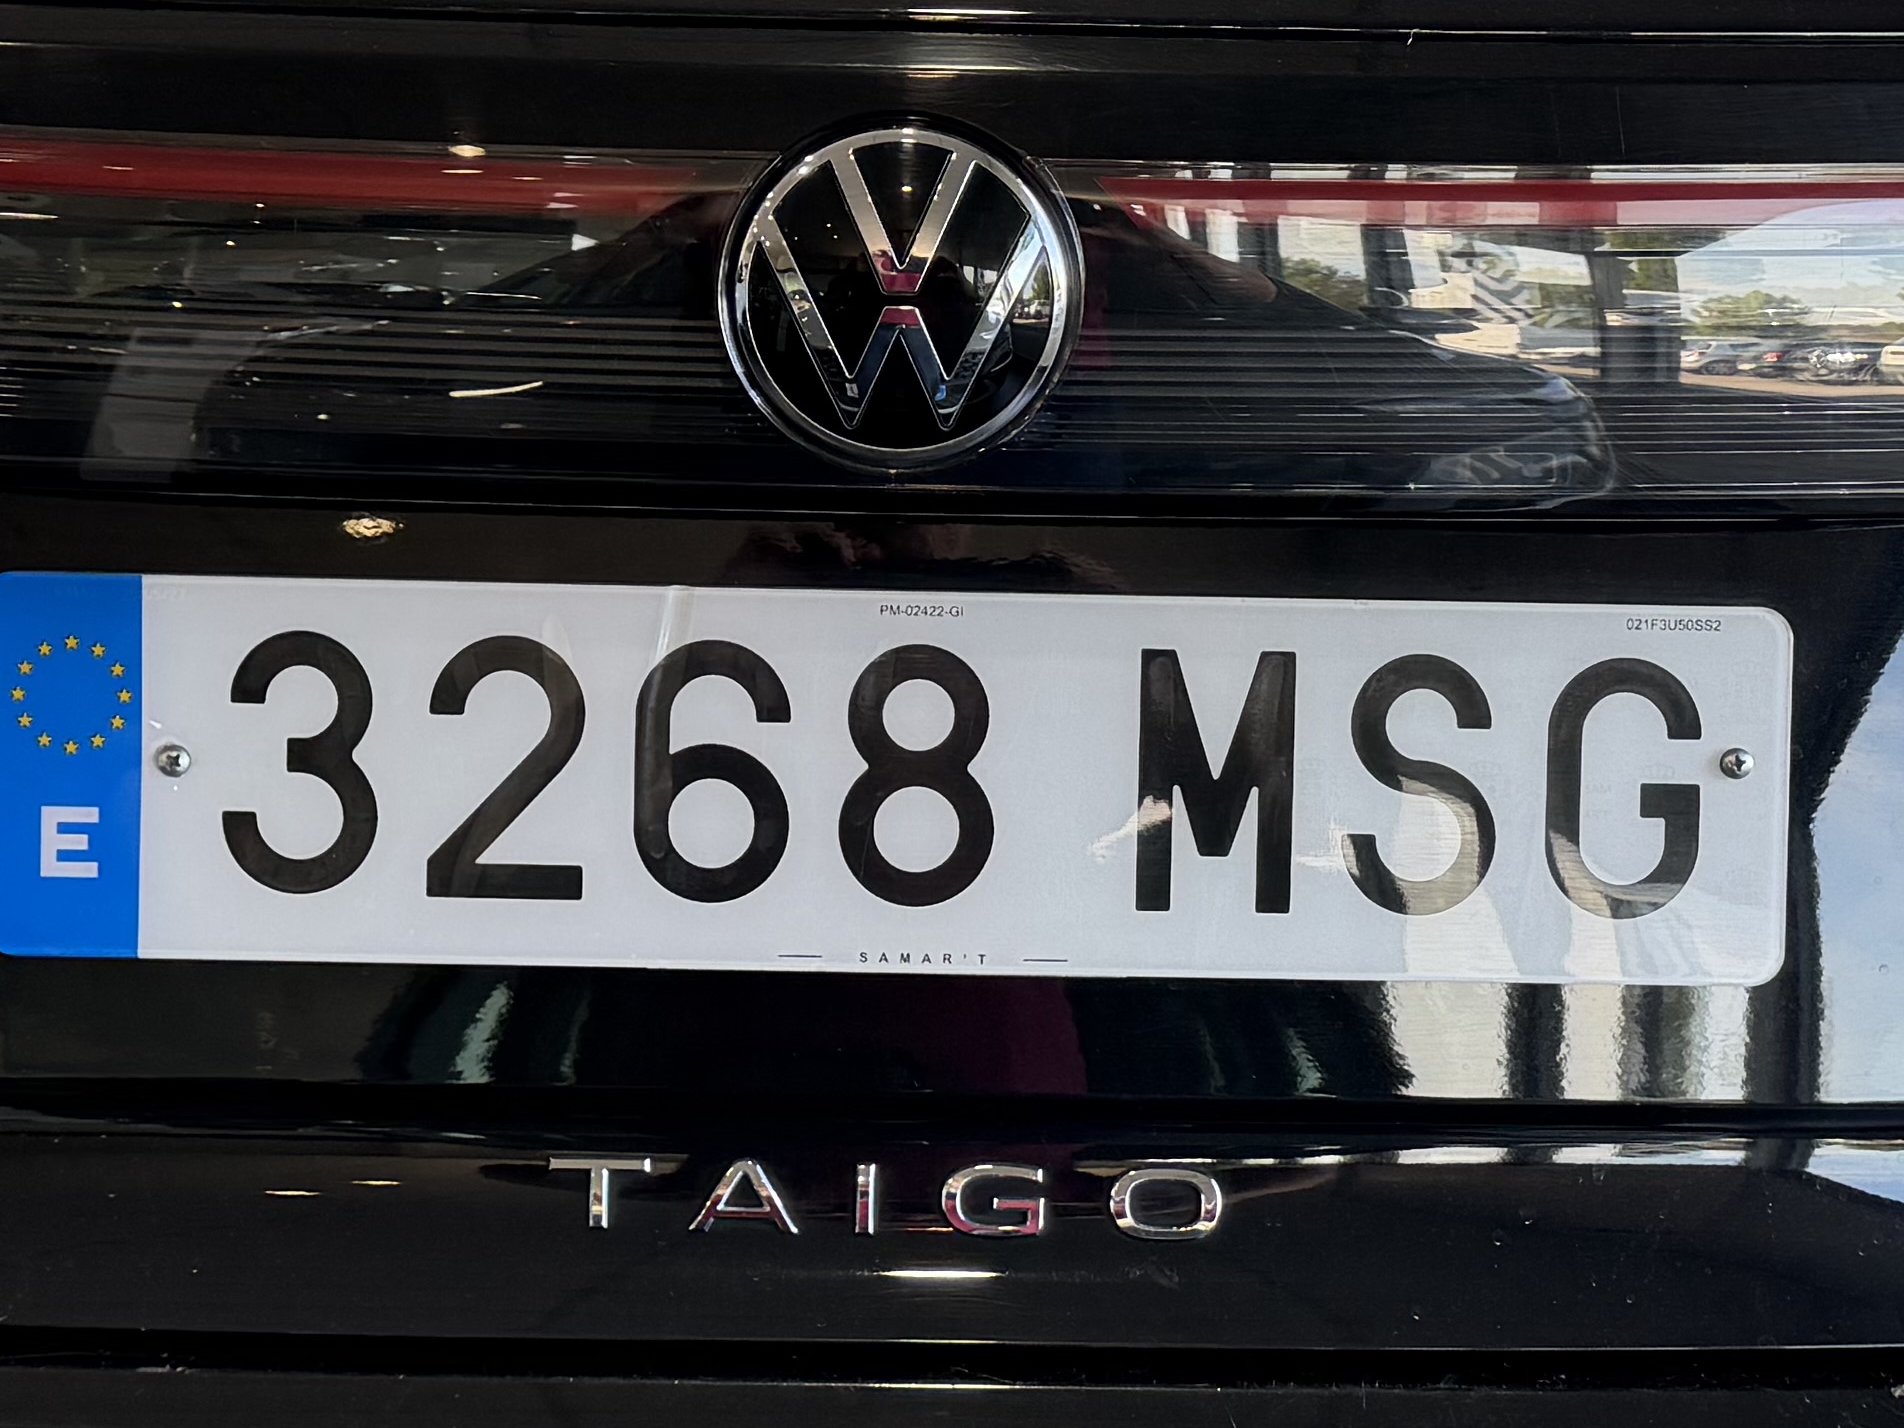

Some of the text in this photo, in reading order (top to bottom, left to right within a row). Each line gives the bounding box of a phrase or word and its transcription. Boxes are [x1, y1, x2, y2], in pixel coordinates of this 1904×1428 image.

[220, 630, 1704, 919] 3268 MSG
[40, 805, 99, 878] E
[548, 1155, 1223, 1240] TAIGO
